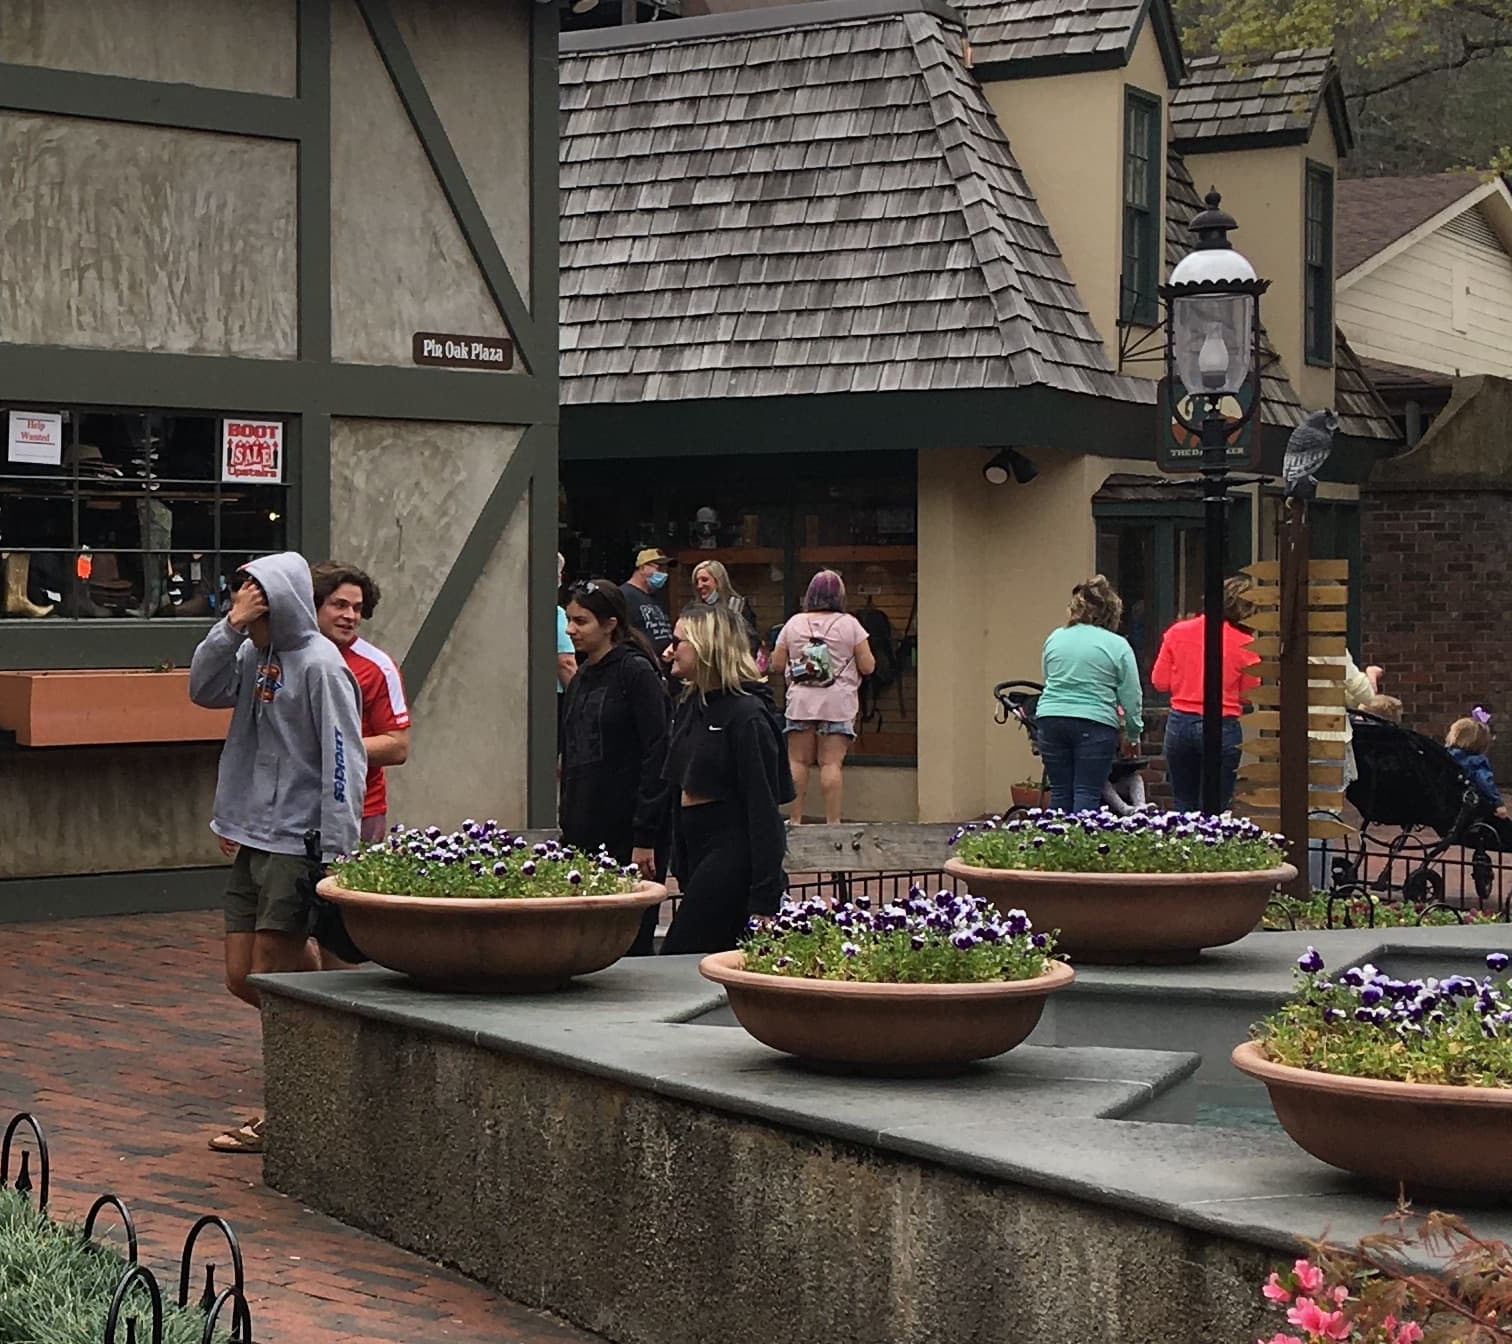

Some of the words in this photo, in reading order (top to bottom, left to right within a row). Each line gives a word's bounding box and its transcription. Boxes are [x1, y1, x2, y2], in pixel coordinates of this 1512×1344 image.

[423, 338, 443, 358] Pin
[445, 340, 469, 359] Oak
[471, 342, 504, 362] Plaza
[27, 419, 46, 432] Help
[228, 423, 279, 439] BOOT
[20, 431, 50, 442] Wanted
[234, 445, 271, 466] SALE
[1170, 449, 1191, 457] THE
